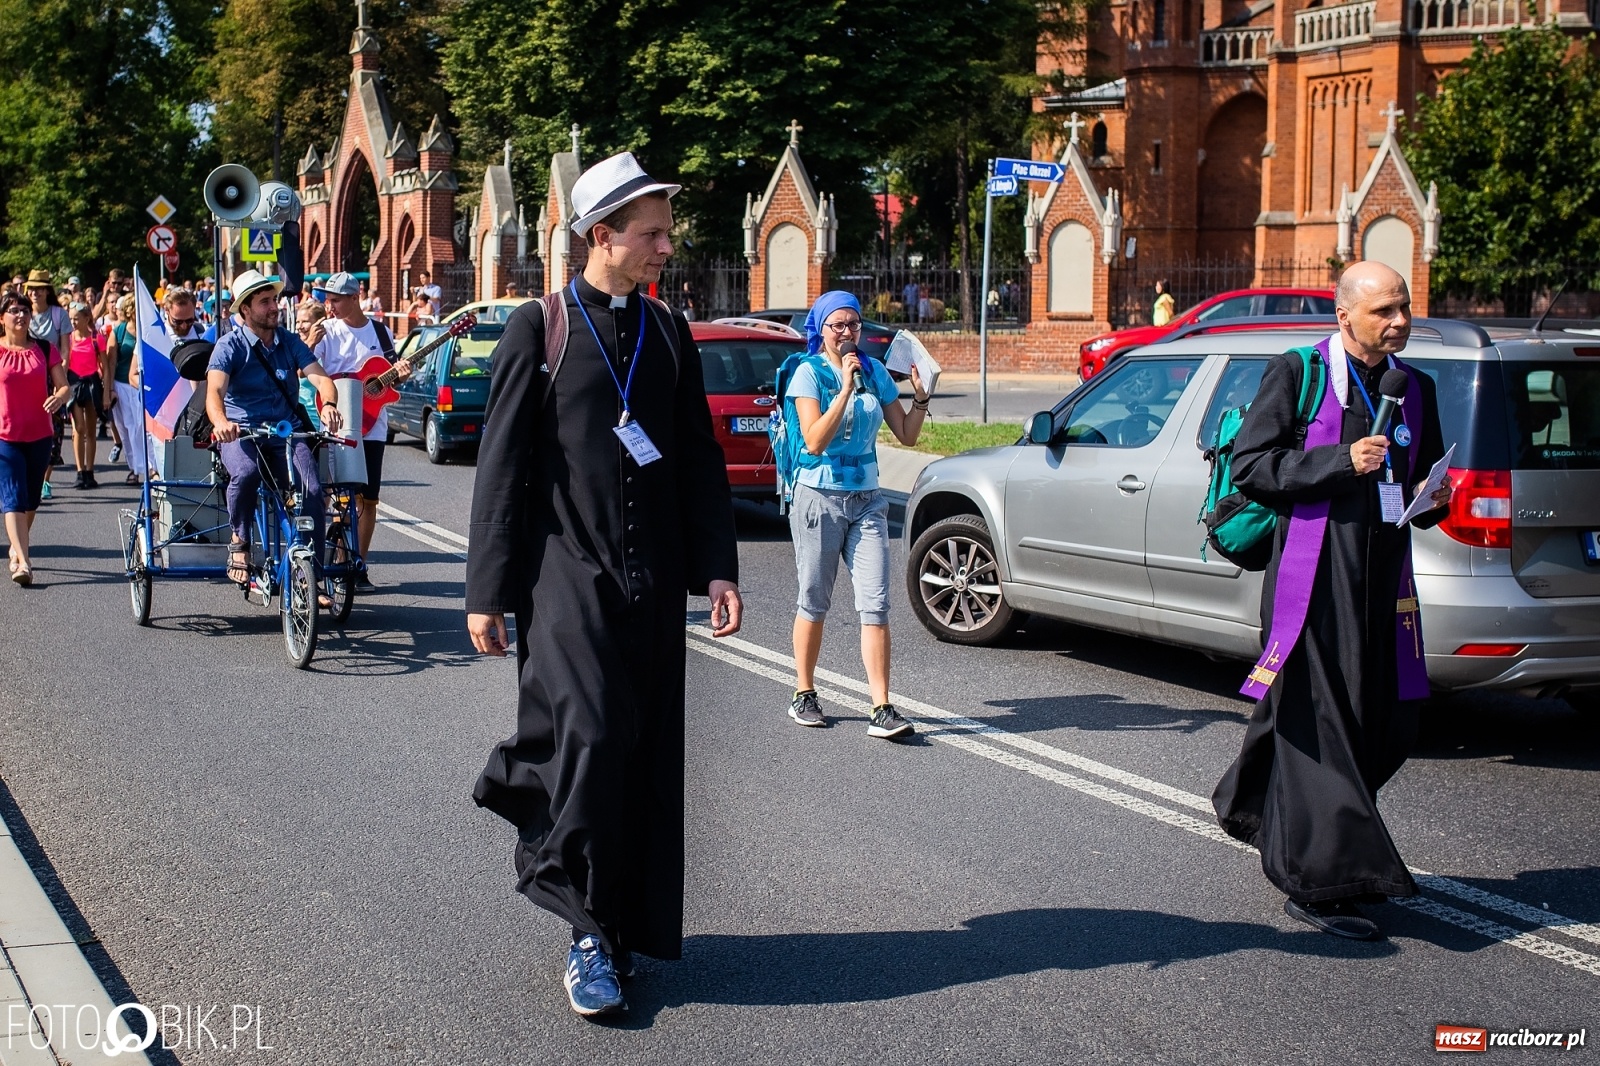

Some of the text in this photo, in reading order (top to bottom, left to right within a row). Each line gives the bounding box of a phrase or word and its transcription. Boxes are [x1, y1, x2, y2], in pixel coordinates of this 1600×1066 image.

[1012, 163, 1051, 178] Plac Okrzei
[739, 418, 763, 431] SRC
